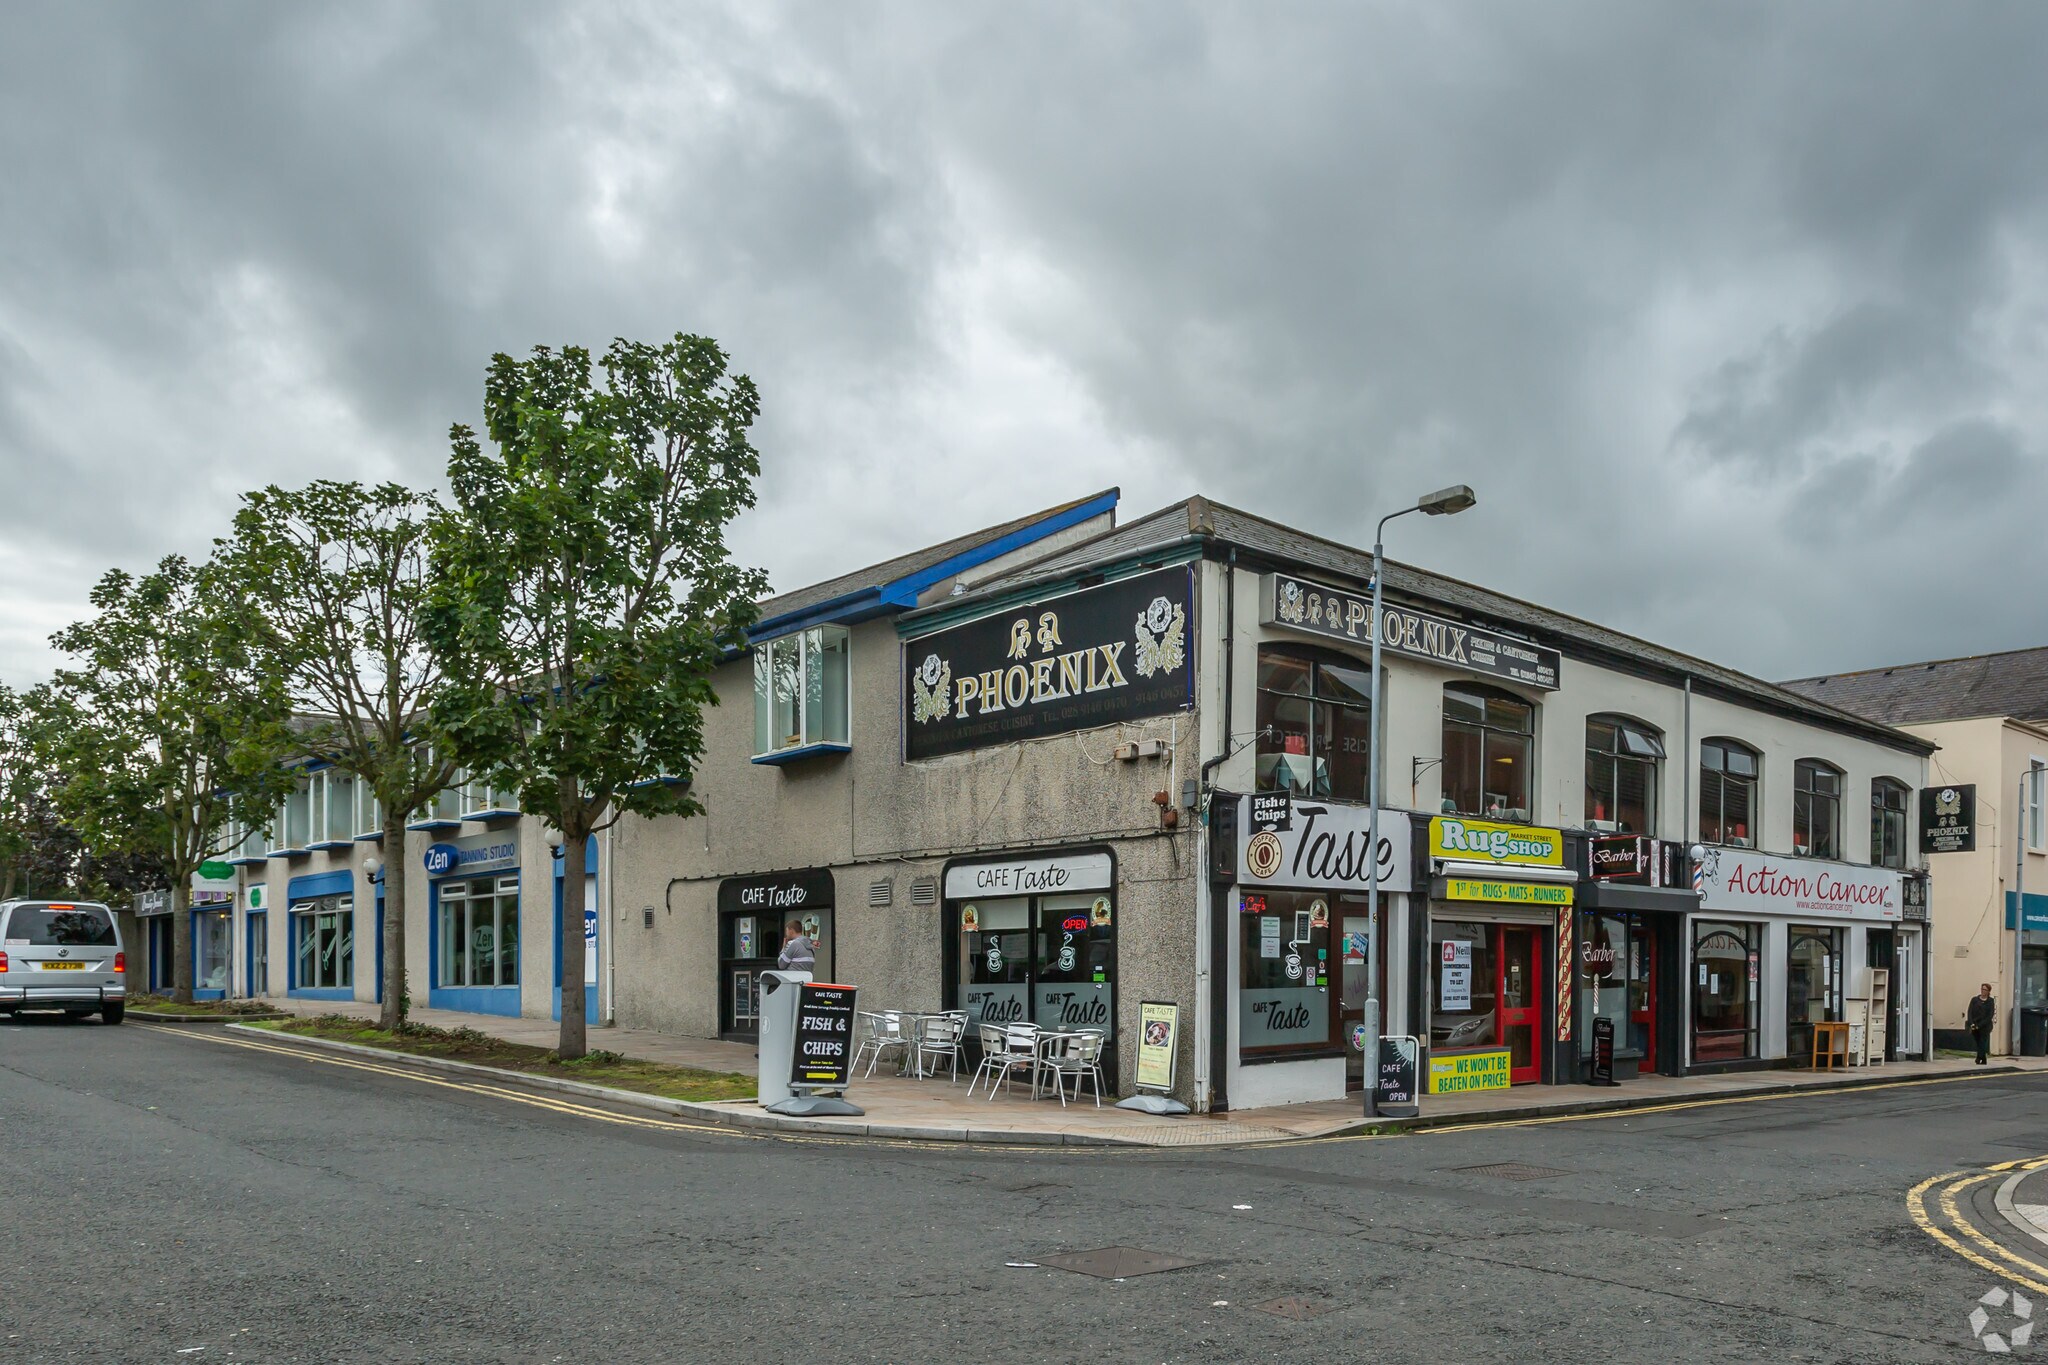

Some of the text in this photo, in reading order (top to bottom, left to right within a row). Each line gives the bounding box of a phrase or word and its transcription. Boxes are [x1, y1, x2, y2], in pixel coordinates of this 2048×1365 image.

[1347, 599, 1468, 664] PHOENIX
[955, 641, 1128, 718] PHOENIX
[1001, 713, 1035, 733] CUISINE
[1254, 796, 1286, 809] Fish &
[1254, 808, 1286, 822] Chips
[1440, 820, 1510, 858] Rug
[1511, 832, 1552, 842] MARKET STREET
[1926, 826, 1969, 837] PHOENIX
[1253, 835, 1276, 847] COFFEE
[1292, 806, 1395, 883] Taste
[1508, 839, 1553, 857] SHOP
[427, 849, 448, 870] Zen
[460, 846, 488, 864] TANNING
[490, 843, 515, 859] STUDIO
[1593, 848, 1636, 864] Barber
[977, 863, 1071, 891] CAFE Taste
[1255, 867, 1272, 876] CAFE
[1469, 882, 1479, 896] for
[1482, 884, 1503, 899] RUGS
[1508, 886, 1528, 900] MATS
[1533, 888, 1566, 902] RUNNERS
[1727, 863, 1889, 905] Action Cancer
[742, 883, 807, 907] CAFE Taste
[1796, 900, 1853, 914] www.actioncancer.org
[585, 917, 596, 935] en
[1063, 919, 1087, 930] OPEN
[475, 930, 493, 947] Zen
[1581, 941, 1616, 962] Barber
[826, 991, 843, 999] TASTE
[967, 991, 1023, 1022] CAFE Taste
[1046, 992, 1108, 1024] CAFE Taste
[1253, 1000, 1310, 1030] CAFE Taste
[802, 1016, 846, 1031] FISH &
[803, 1041, 843, 1056] CHIPS
[1382, 1064, 1401, 1073] CAFE
[1456, 1056, 1507, 1074] WE WON'T BE
[1379, 1079, 1400, 1090] Taste
[1438, 1072, 1507, 1092] BEATEN ON PRICE!
[1388, 1092, 1407, 1101] OPEN
